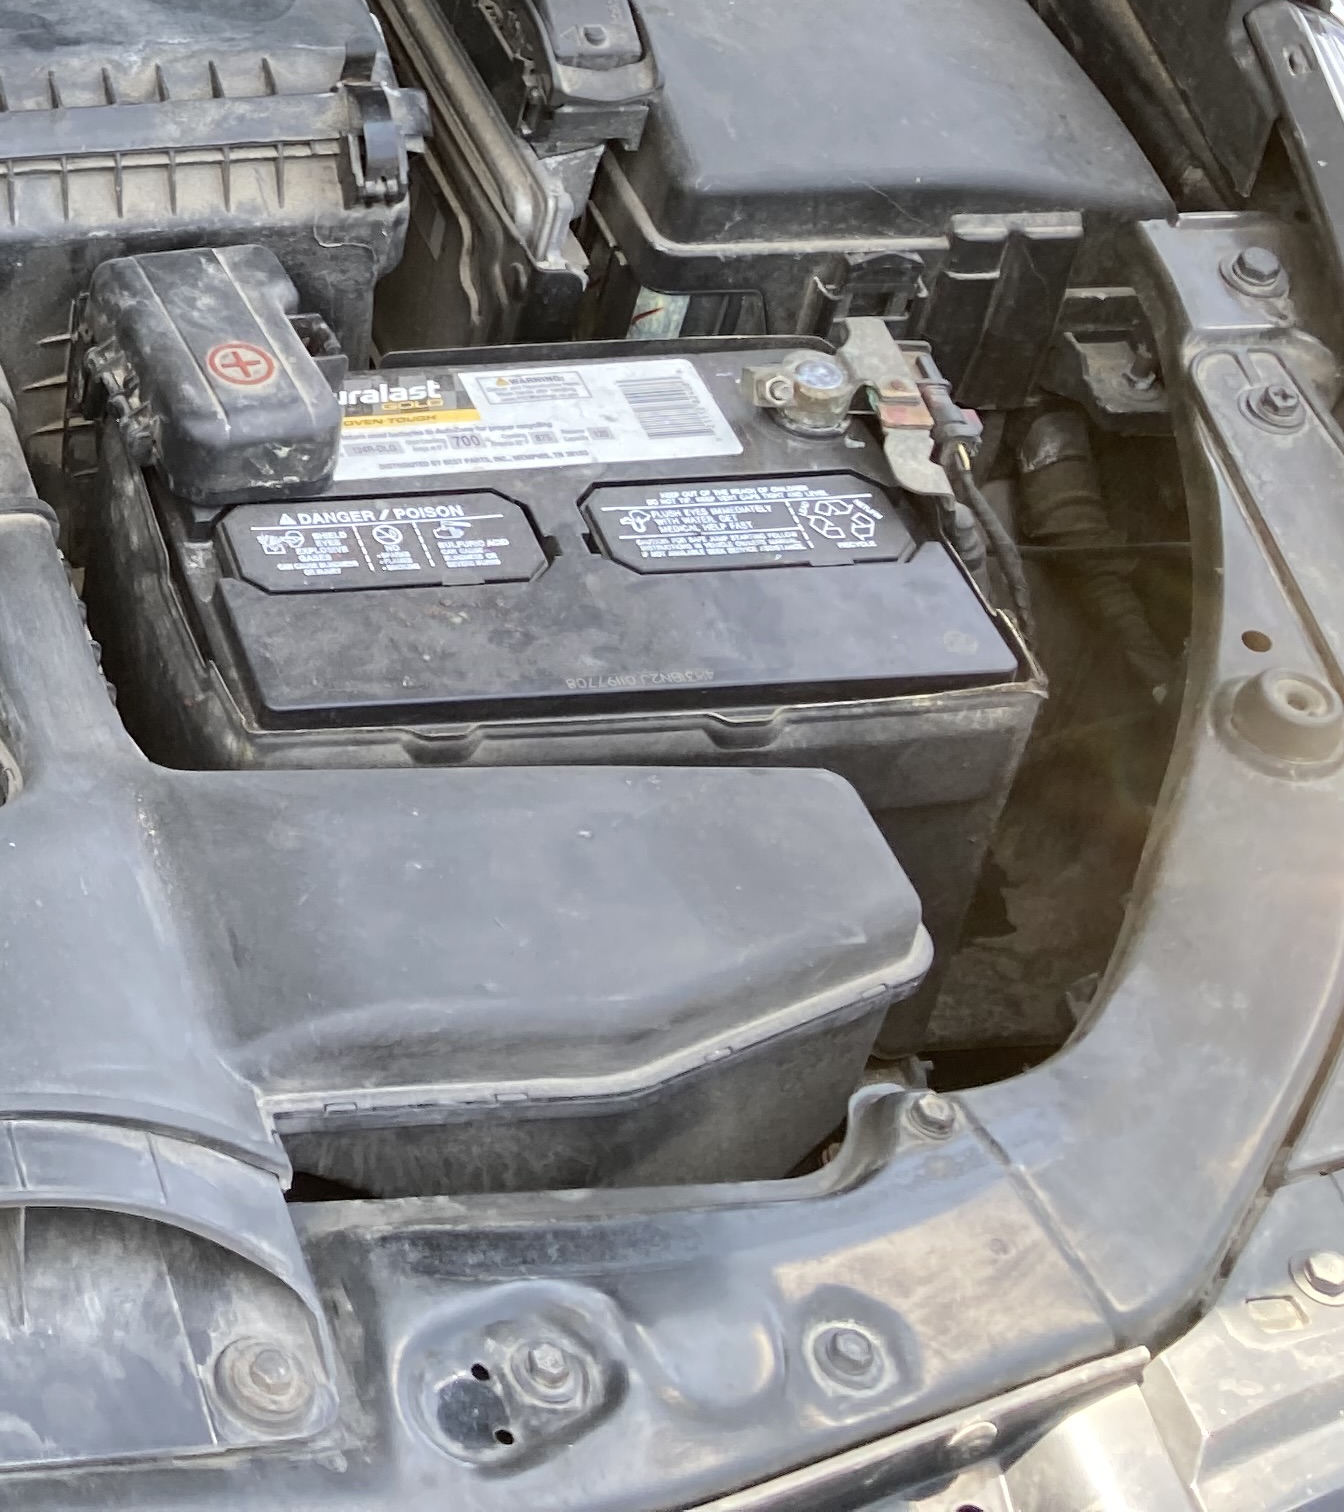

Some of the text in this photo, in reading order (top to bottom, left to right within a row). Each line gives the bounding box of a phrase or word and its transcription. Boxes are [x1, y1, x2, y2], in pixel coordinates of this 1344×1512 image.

[333, 380, 441, 405] uralast
[382, 398, 444, 411] GOLD
[344, 415, 436, 427] OVEN TOUGH
[454, 435, 481, 447] 700
[297, 510, 376, 524] DANGER
[392, 505, 464, 519] POISON
[650, 505, 772, 518] FLUSH EYES IMMEDIATELY
[654, 517, 681, 526] WITH
[718, 514, 738, 522] GET
[658, 521, 753, 533] MEDICAL HELP FAST
[836, 540, 878, 548] RECYCLE
